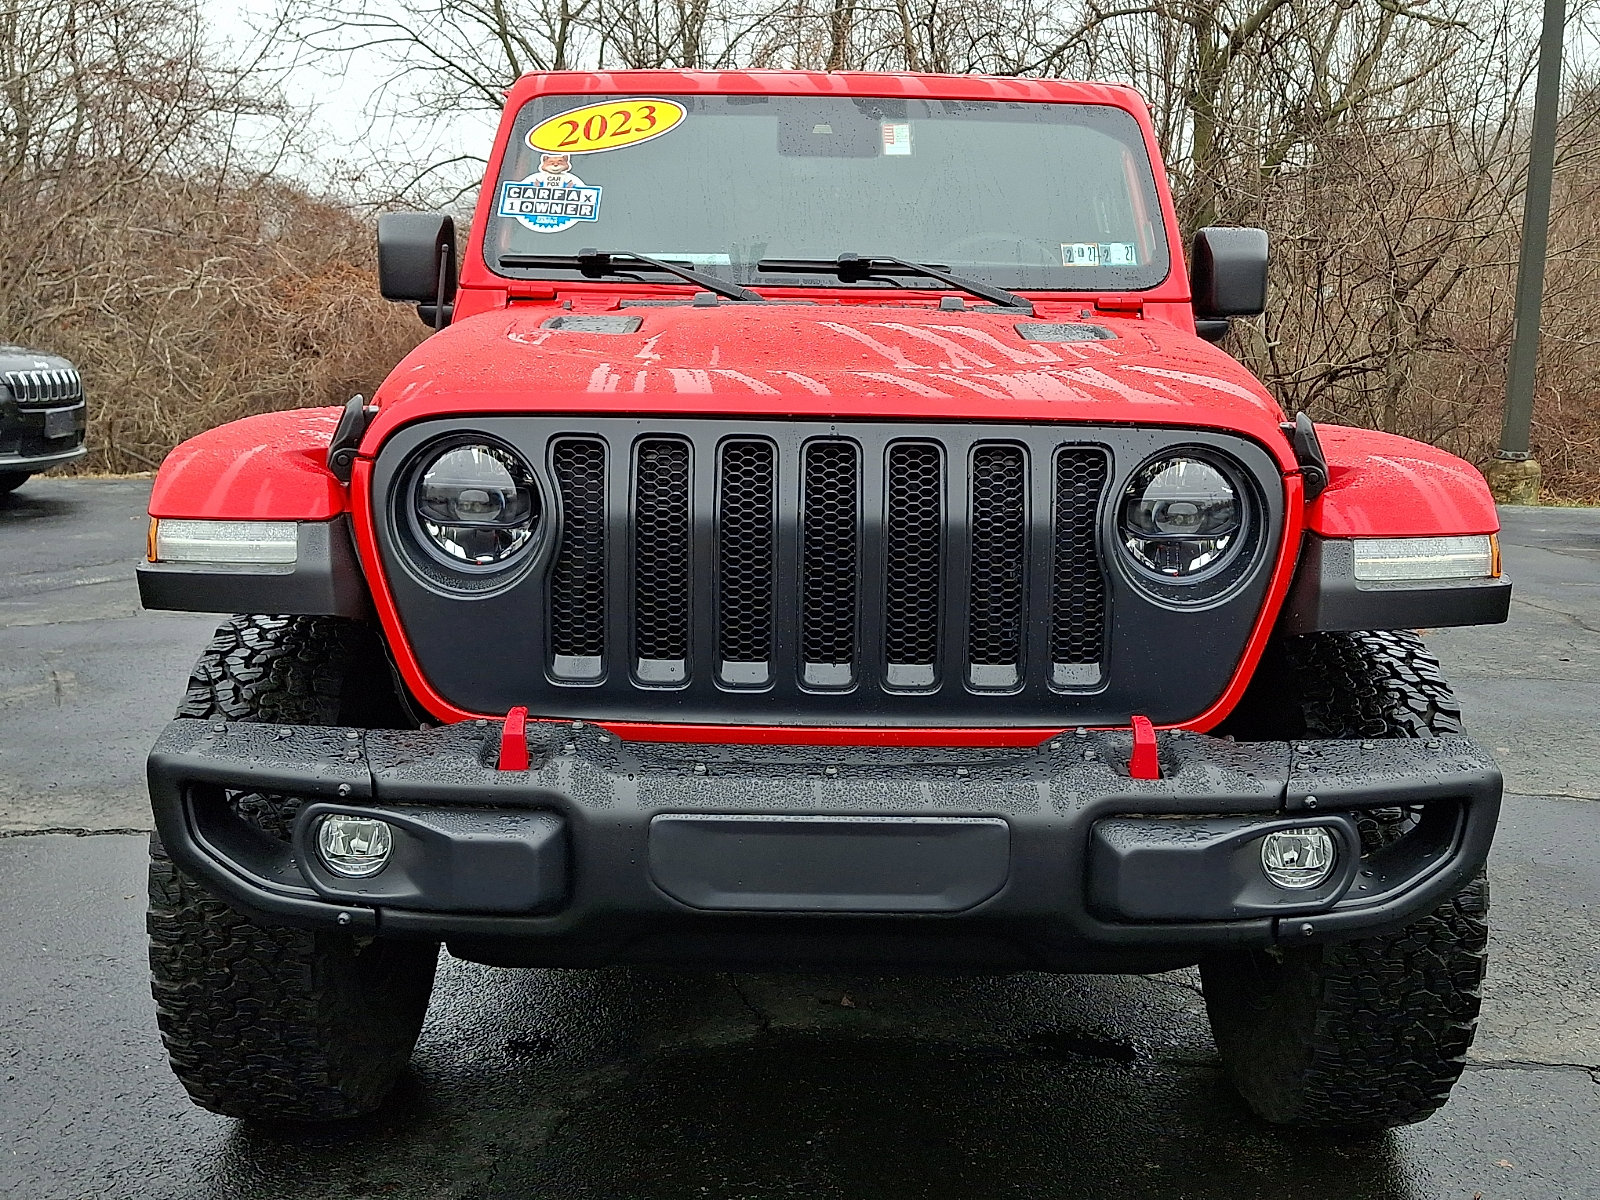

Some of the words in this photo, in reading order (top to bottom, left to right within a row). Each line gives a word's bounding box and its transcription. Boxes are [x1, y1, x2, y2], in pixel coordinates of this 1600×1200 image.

[557, 105, 657, 147] 2023
[508, 187, 593, 202] CARFAX
[508, 202, 515, 210] 1
[520, 201, 593, 216] OWNER
[1088, 246, 1096, 262] 27
[1124, 245, 1133, 261] 27
